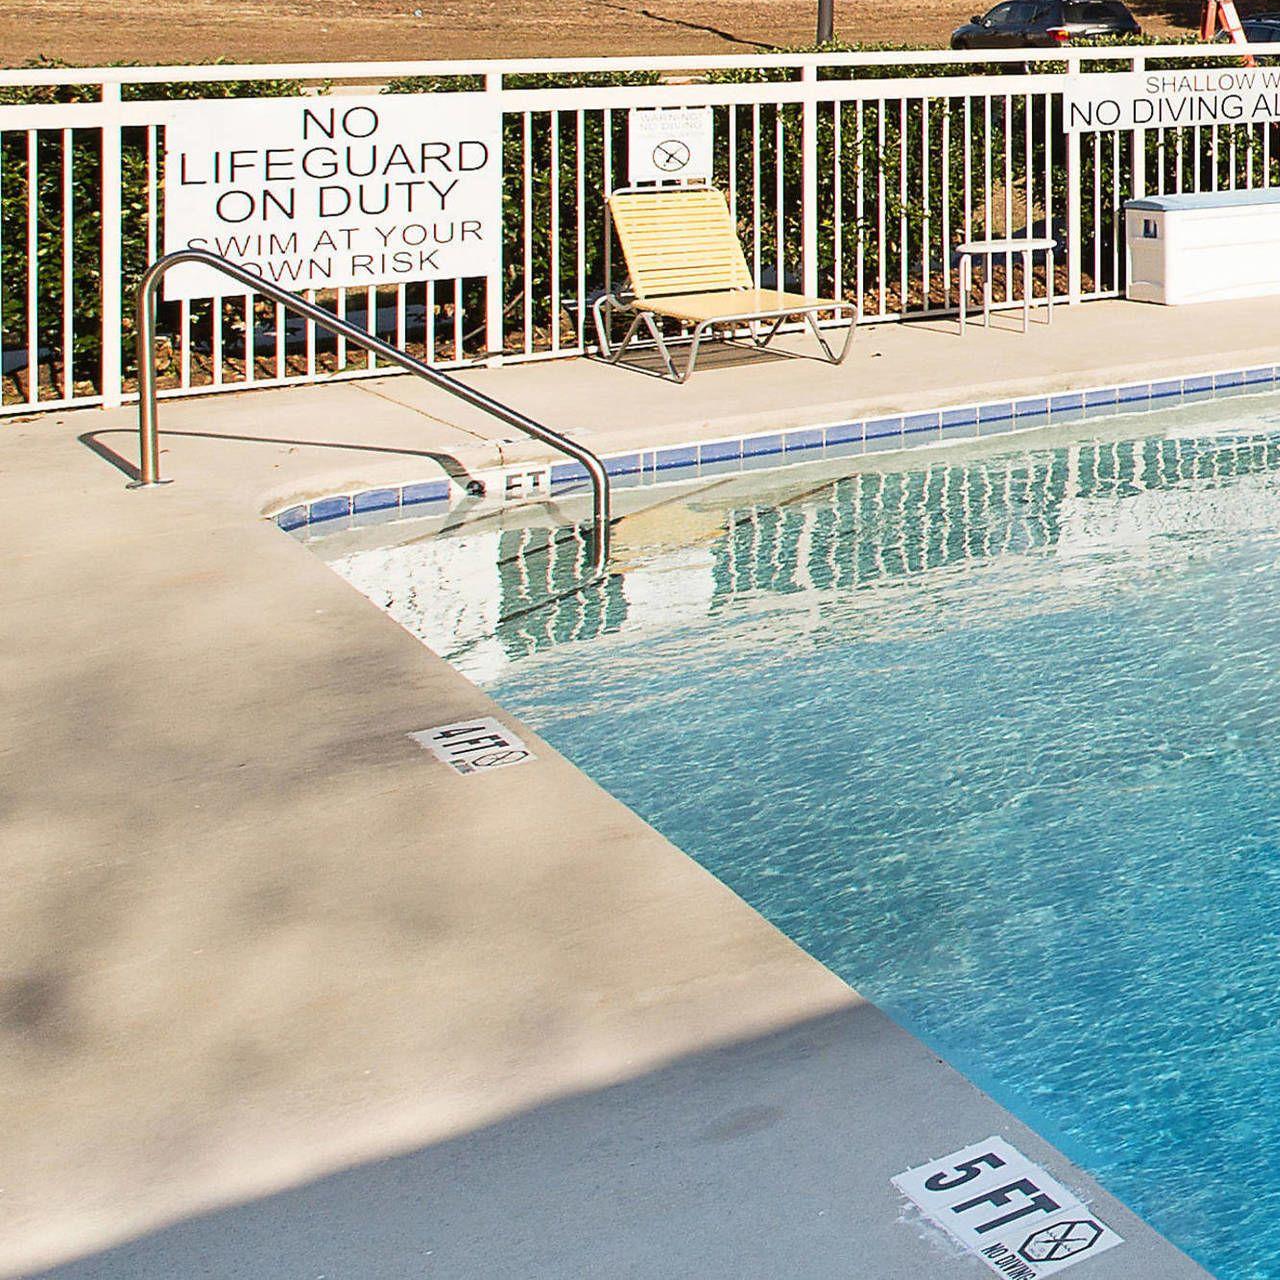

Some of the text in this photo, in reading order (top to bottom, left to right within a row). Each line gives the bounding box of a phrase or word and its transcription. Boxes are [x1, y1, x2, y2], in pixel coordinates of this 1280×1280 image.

[1145, 73, 1255, 94] SHALLOW
[302, 105, 380, 141] NO
[1069, 99, 1121, 128] NO
[1132, 94, 1243, 125] DIVING
[180, 140, 490, 186] LIFEGUARD
[215, 179, 460, 224] ON DUTY
[313, 228, 361, 253] AT
[373, 220, 484, 248] YOUR
[350, 249, 441, 277] RISK
[924, 1152, 1062, 1235] 5 FT
[980, 1242, 1009, 1259] NO
